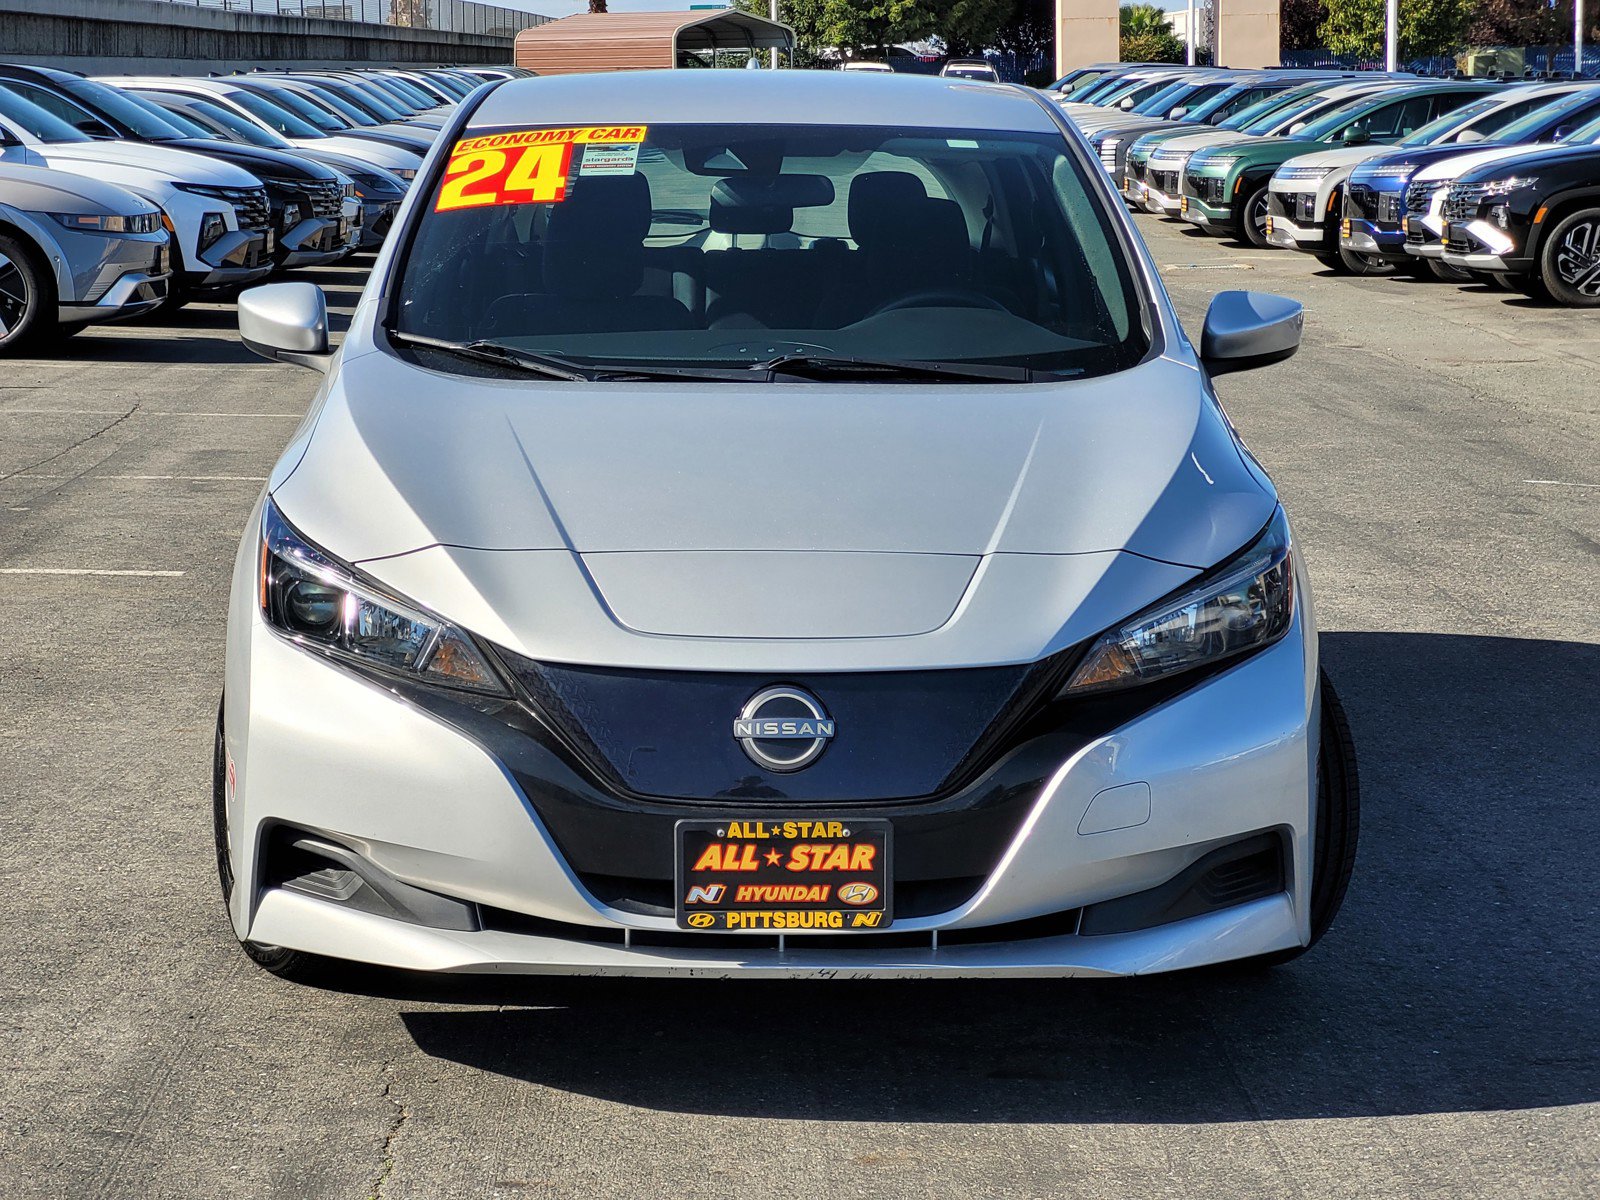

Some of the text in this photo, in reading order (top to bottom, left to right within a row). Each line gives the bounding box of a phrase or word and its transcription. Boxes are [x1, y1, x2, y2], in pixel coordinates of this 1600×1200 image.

[456, 128, 641, 153] ECONOMY CAR
[437, 144, 566, 211] 24
[737, 722, 833, 735] NISSAN
[727, 822, 843, 839] ALL STAR
[691, 843, 876, 872] ALL STAR
[734, 885, 832, 902] HYUNDAI
[726, 911, 843, 928] PITTSBURG
